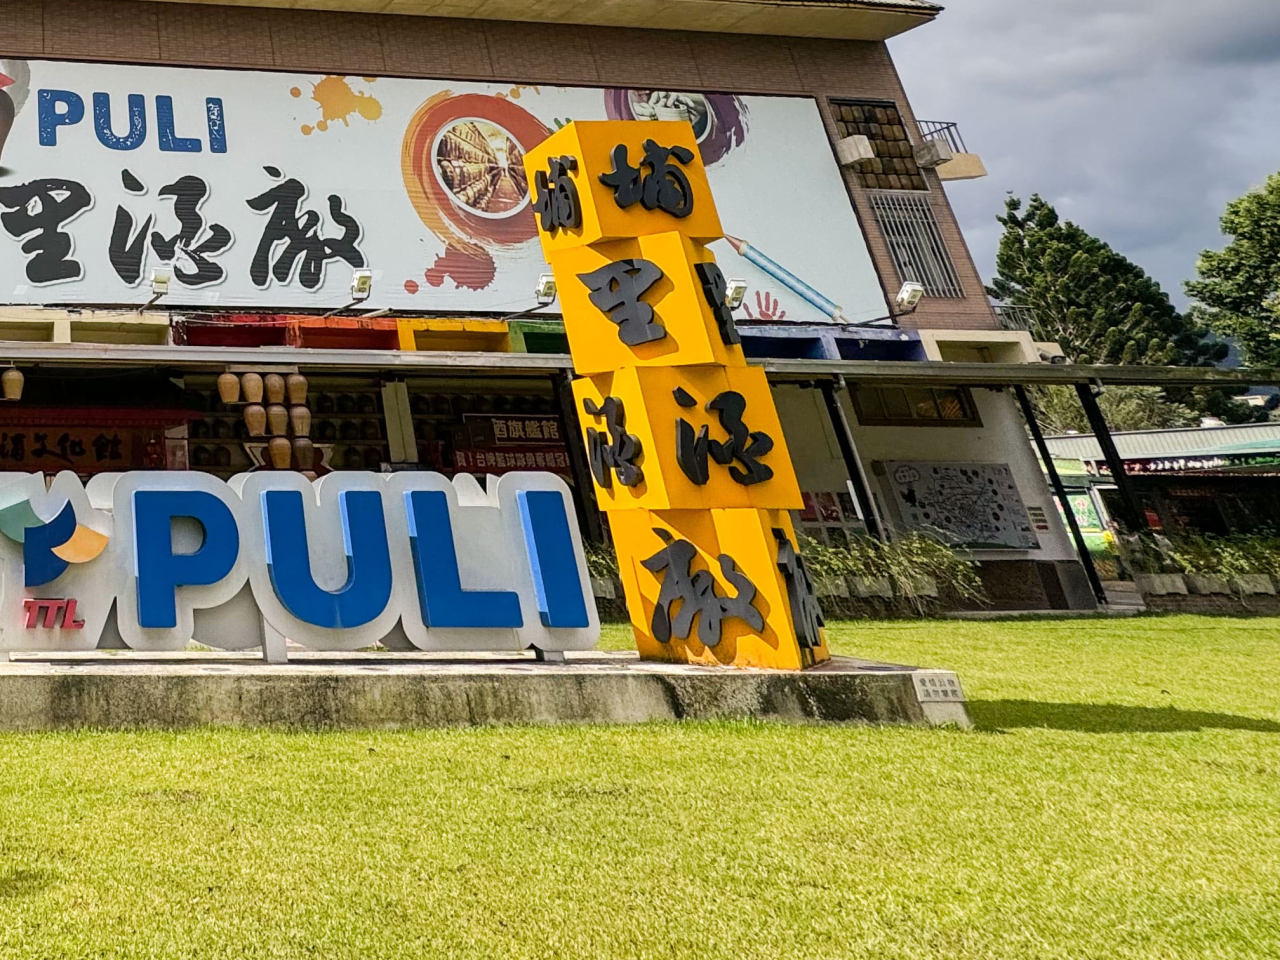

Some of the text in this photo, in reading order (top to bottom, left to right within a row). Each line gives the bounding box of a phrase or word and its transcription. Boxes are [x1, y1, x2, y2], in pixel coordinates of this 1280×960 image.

[37, 88, 228, 154] PULI
[133, 489, 590, 629] PULI
[22, 597, 86, 630] TTL
